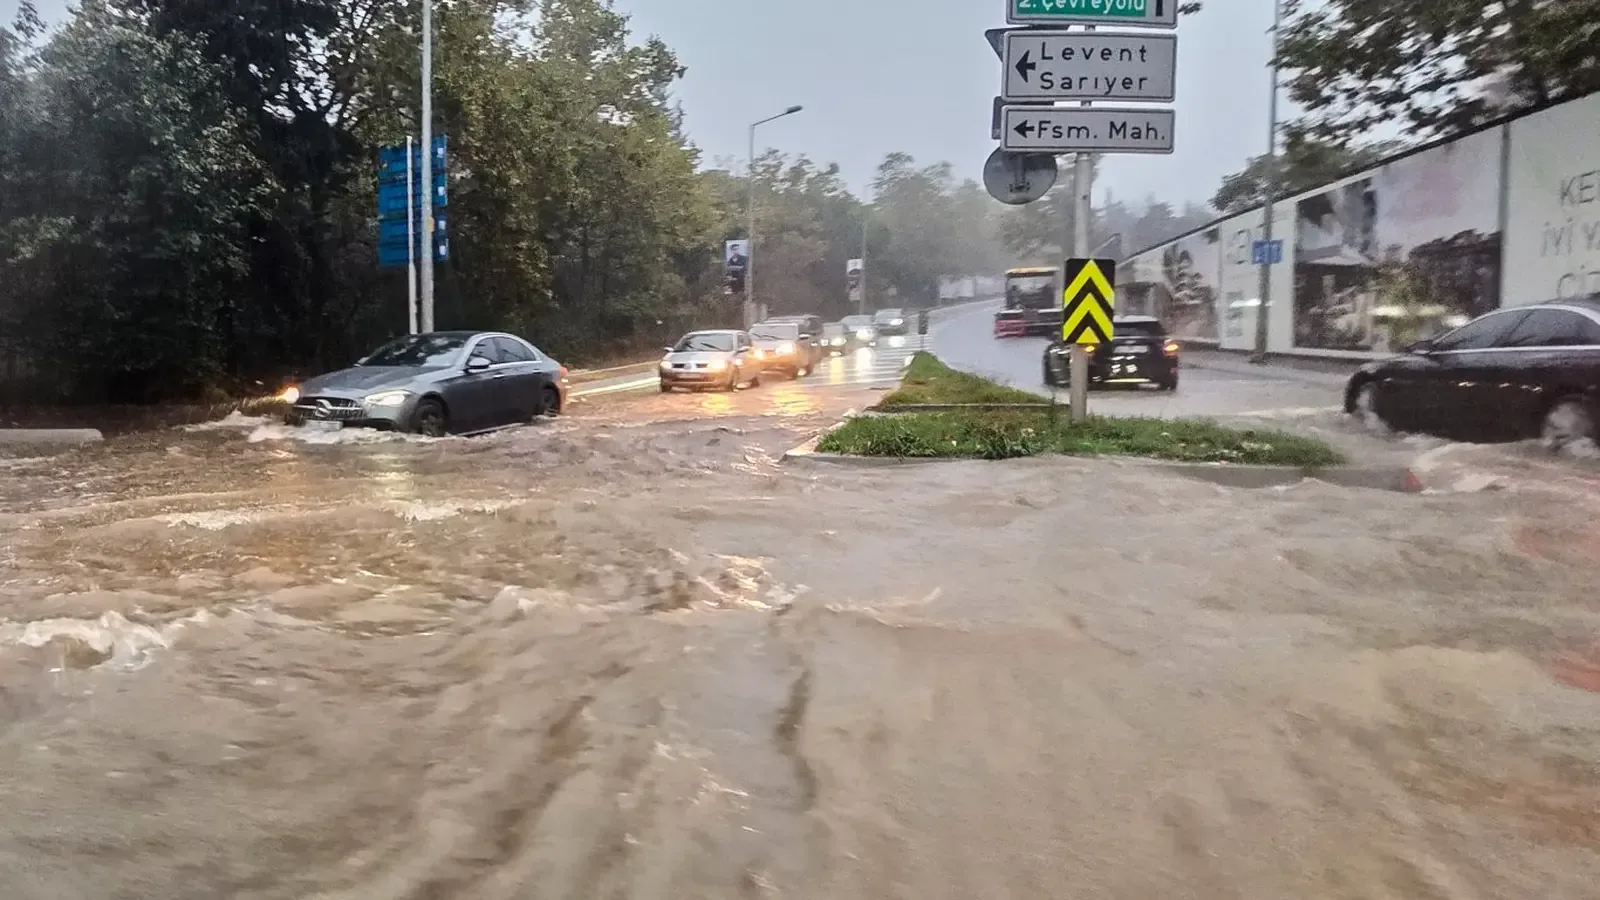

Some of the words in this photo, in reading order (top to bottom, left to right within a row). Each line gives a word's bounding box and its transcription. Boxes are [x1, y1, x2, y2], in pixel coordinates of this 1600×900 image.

[1042, 0, 1145, 14] Çevreyolu
[1040, 42, 1147, 63] Levent
[1039, 72, 1149, 95] Sarıyer
[1037, 120, 1098, 139] Fsm.
[1108, 121, 1166, 140] Mah.
[1560, 170, 1600, 207] KE
